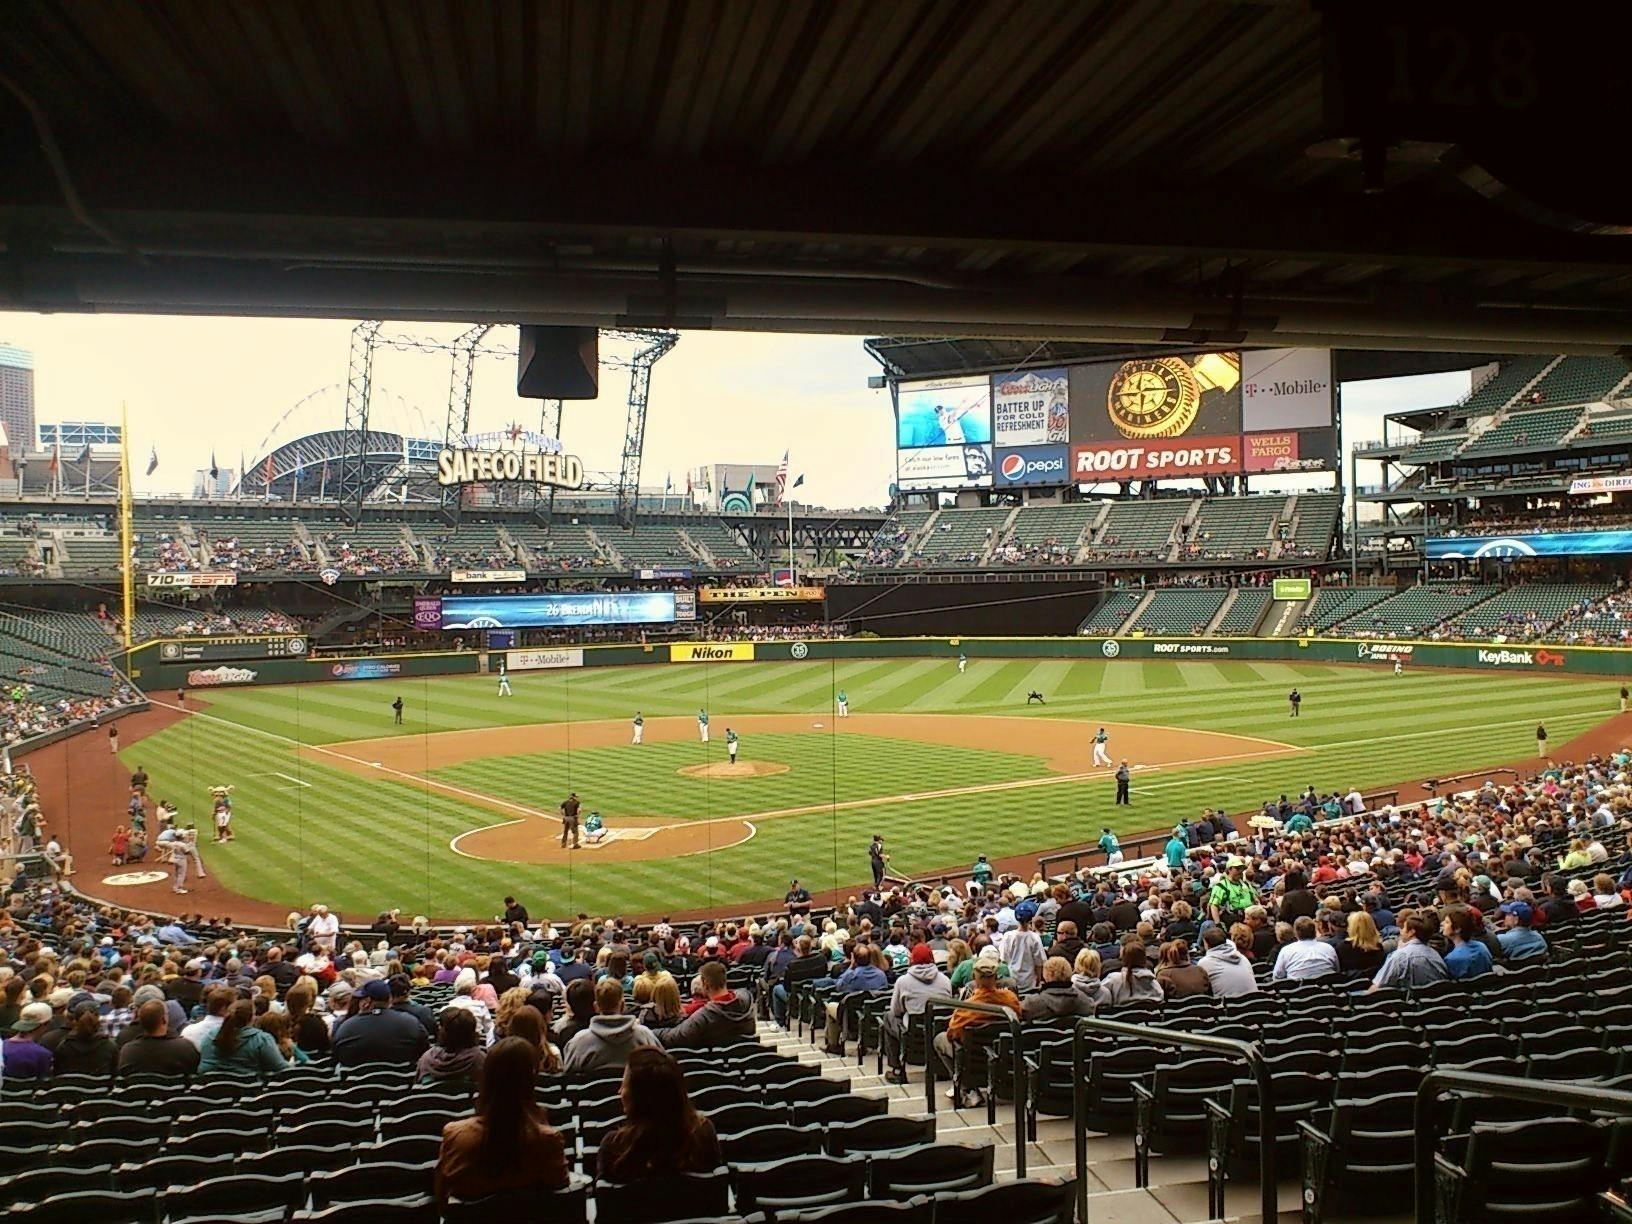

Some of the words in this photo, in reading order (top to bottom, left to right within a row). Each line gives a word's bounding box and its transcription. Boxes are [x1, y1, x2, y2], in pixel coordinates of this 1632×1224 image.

[1387, 25, 1540, 110] 128
[996, 401, 1030, 414] BATTER
[1032, 400, 1045, 412] UP
[1019, 412, 1045, 420] COLD
[996, 419, 1045, 432] REFRESHMENT
[1250, 436, 1291, 447] WELLS
[1251, 446, 1291, 456] FARGO
[1076, 448, 1145, 472] ROOT
[437, 447, 521, 486] SAFECO
[522, 453, 584, 490] FIELD
[1026, 457, 1063, 475] pepsi
[1573, 481, 1591, 489] ING
[149, 575, 174, 585] 710
[191, 574, 236, 585] ESPN
[709, 589, 749, 598] THE
[675, 595, 694, 604] BUILT
[691, 646, 733, 660] Nikon
[1153, 643, 1181, 653] ROOT
[1371, 644, 1414, 654] BOEING
[1478, 649, 1533, 665] KeyBank
[222, 671, 257, 682] LIGHT
